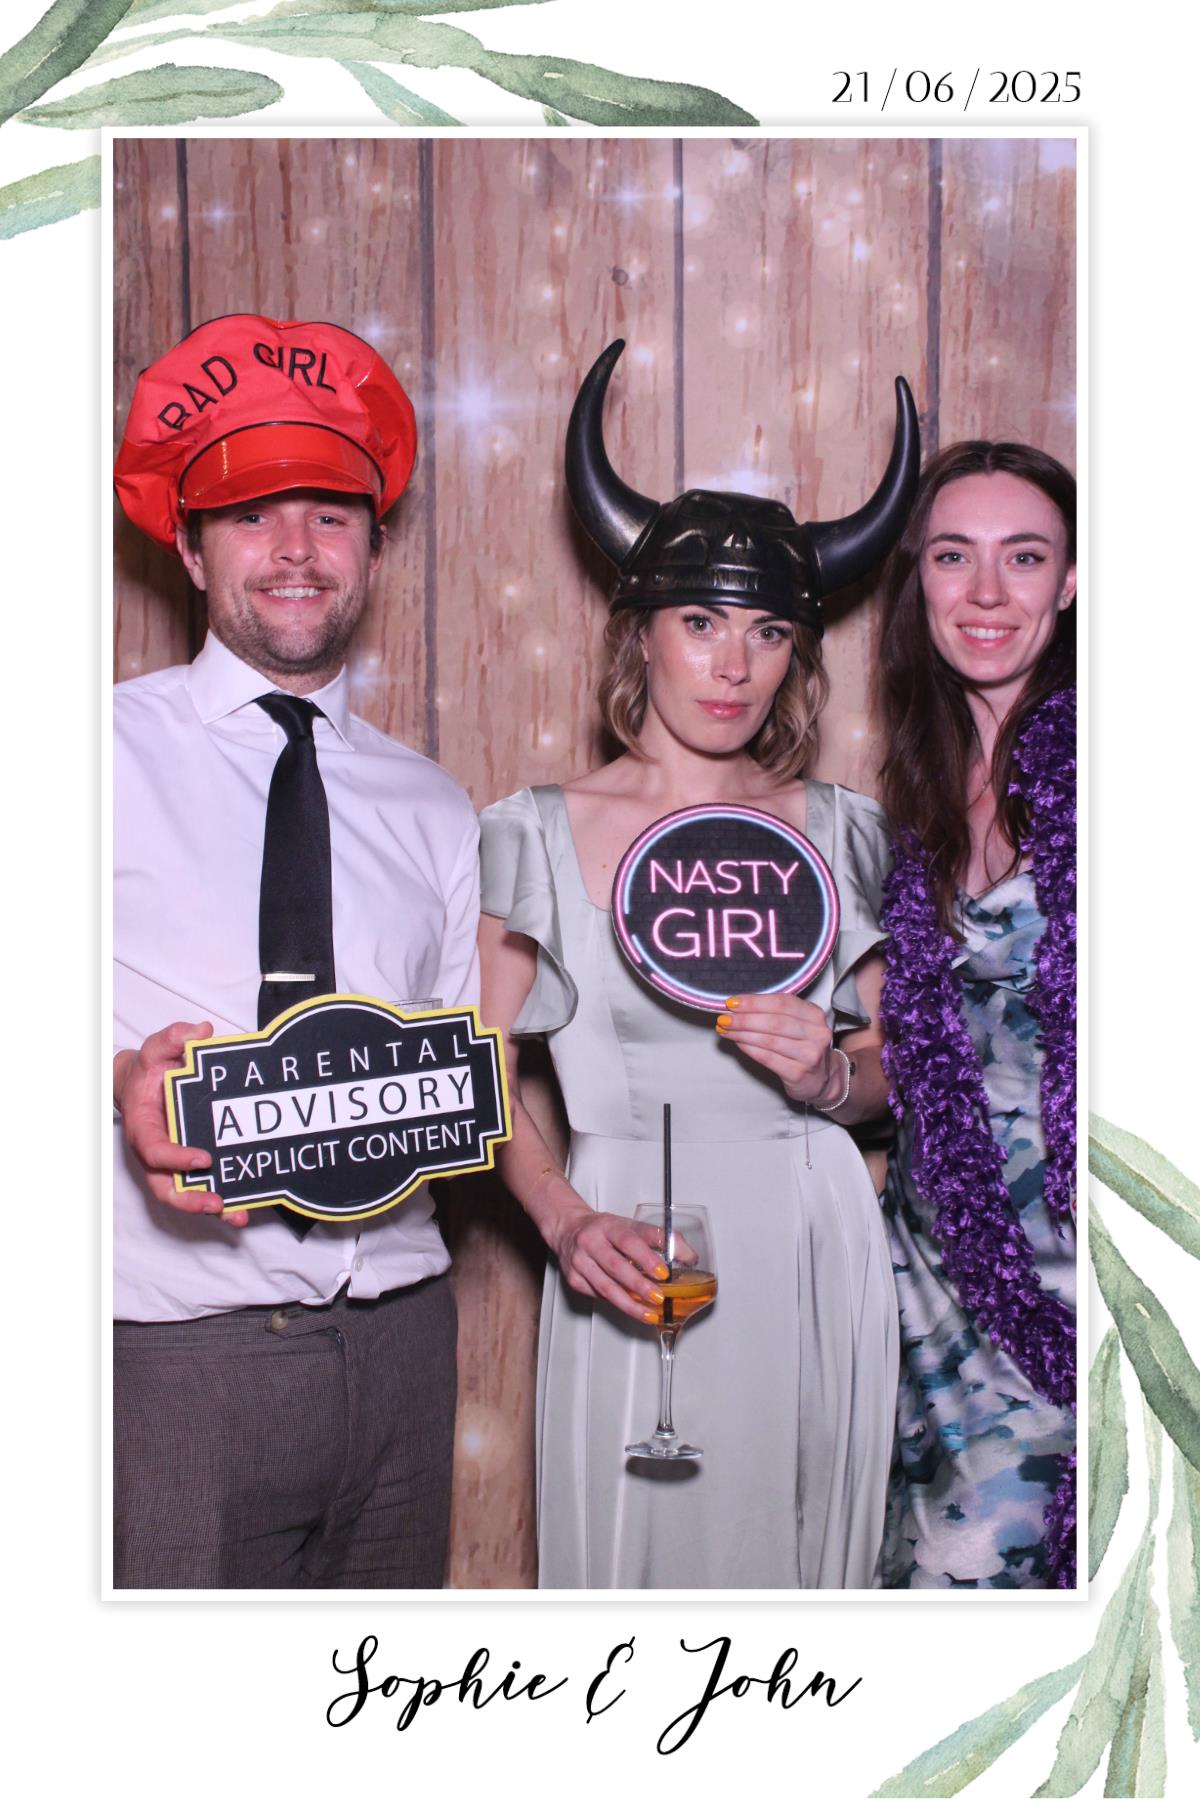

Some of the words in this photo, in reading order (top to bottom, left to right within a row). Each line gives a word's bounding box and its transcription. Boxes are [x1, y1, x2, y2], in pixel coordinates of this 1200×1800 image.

[158, 355, 238, 431] BAD
[253, 342, 336, 394] GIRL
[650, 859, 800, 895] NASTY
[652, 907, 806, 959] GIRL
[211, 1034, 468, 1092] PARENTAL
[216, 1071, 470, 1141] ADVISORY
[219, 1141, 340, 1184] EXPLICIT
[347, 1119, 476, 1161] CONTENT
